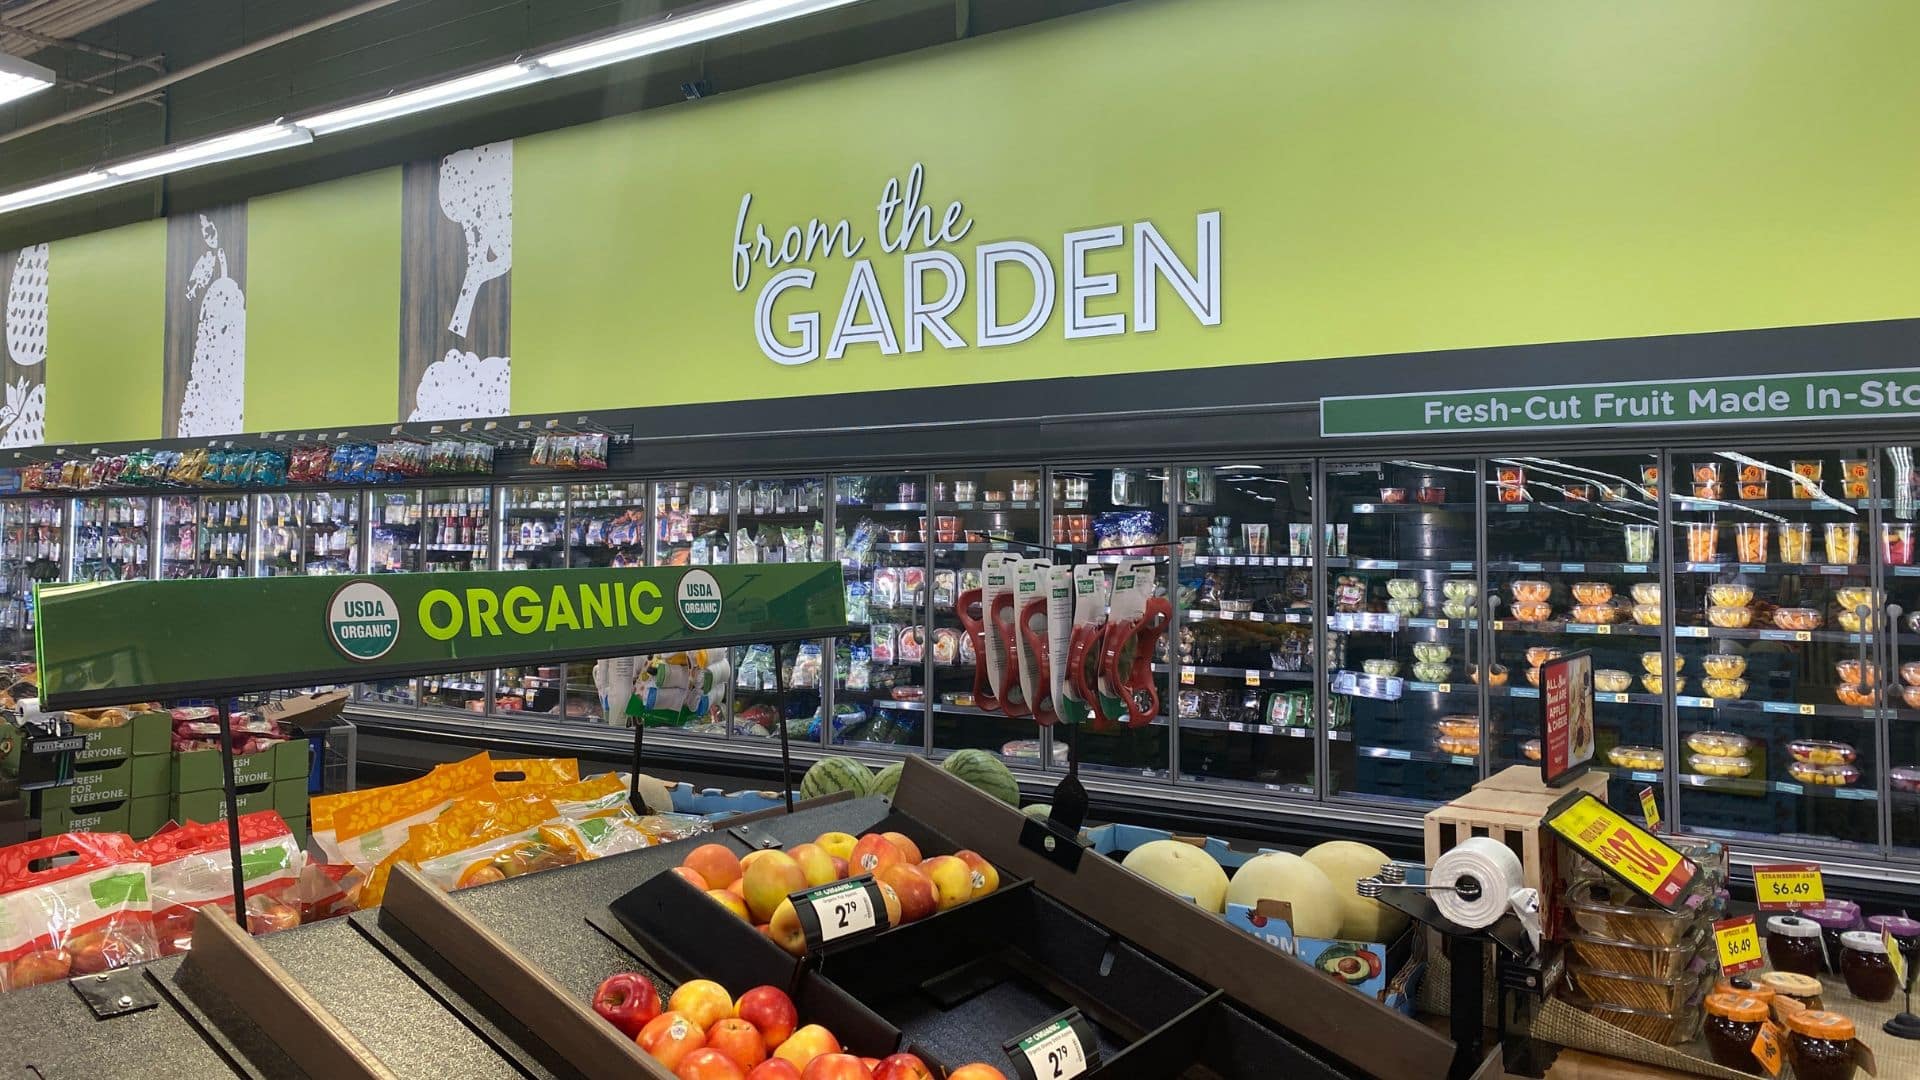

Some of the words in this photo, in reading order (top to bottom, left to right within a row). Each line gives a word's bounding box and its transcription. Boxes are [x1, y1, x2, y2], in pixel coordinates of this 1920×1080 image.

[732, 193, 865, 292] from
[876, 162, 974, 252] the
[754, 210, 1223, 366] GARDEN
[1424, 395, 1582, 425] Fresh-Cut
[1595, 390, 1675, 418] Fruit
[1689, 383, 1790, 415] Made
[686, 582, 713, 598] USDA
[344, 599, 386, 618] USDA
[418, 580, 663, 641] ORGANIC
[685, 602, 718, 615] ORGANIC
[340, 623, 392, 640] ORGANIC
[233, 758, 250, 768] ESH
[71, 785, 92, 795] FOR
[69, 817, 101, 829] FRESH
[1773, 881, 1810, 895] $6.49
[1728, 938, 1751, 955] $6.49
